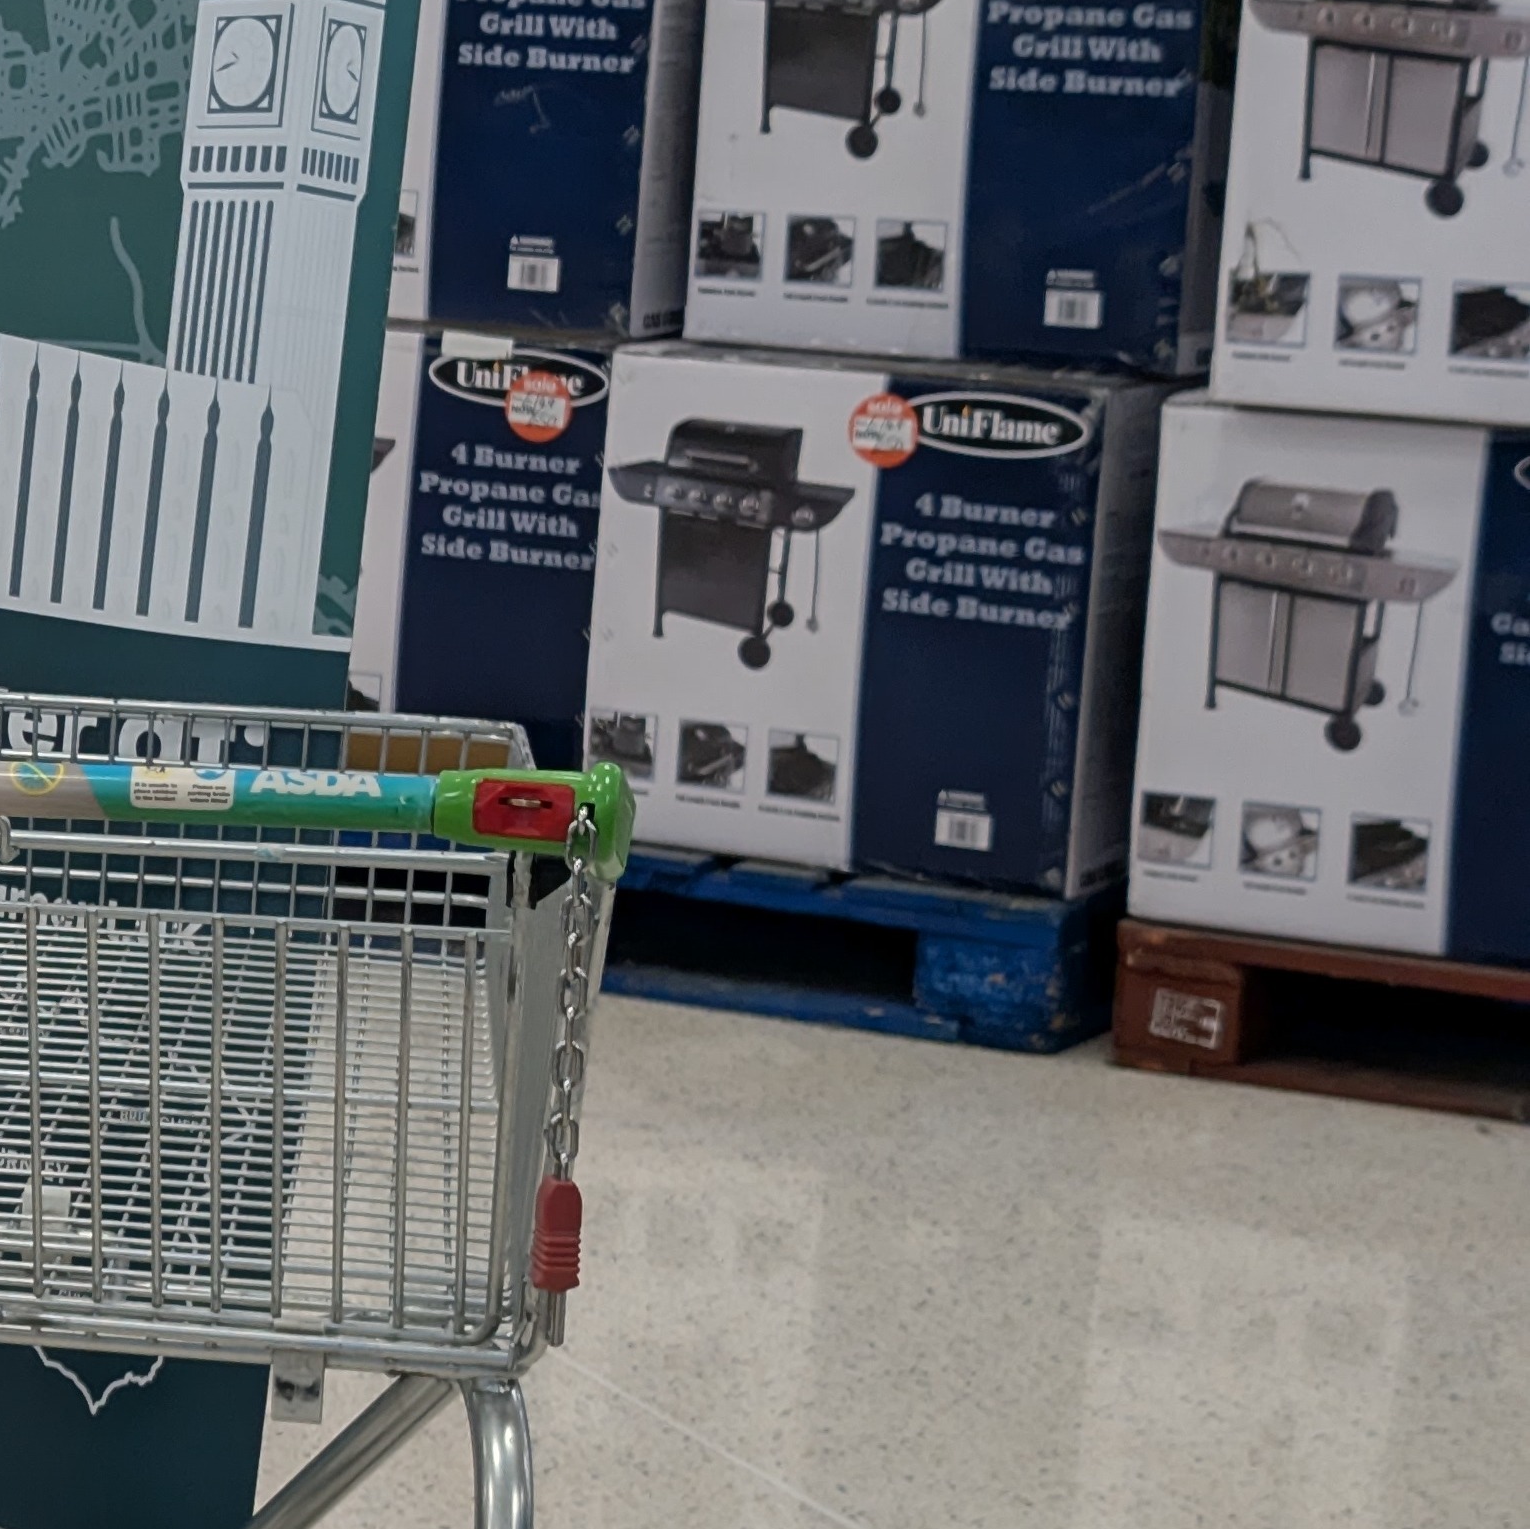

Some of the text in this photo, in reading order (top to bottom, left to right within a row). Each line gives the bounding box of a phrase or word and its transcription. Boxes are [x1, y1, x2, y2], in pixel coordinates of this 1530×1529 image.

[479, 14, 617, 40] Grill With
[987, 0, 1194, 32] Propane Gas
[457, 43, 636, 73] Side Burner
[1012, 34, 1162, 63] Grill With
[988, 67, 1183, 98] Side Burner
[922, 404, 1061, 445] UniFlame
[450, 442, 582, 475] 4 Burner
[419, 471, 546, 504] Propane
[442, 505, 580, 538] Grill With
[914, 493, 1055, 529] 4 Burner
[421, 533, 594, 571] Side Burner
[880, 522, 1085, 566] Propane Gas
[905, 558, 1054, 596] Grill With
[881, 588, 1071, 631] Side Burner
[249, 769, 383, 798] ASDA
